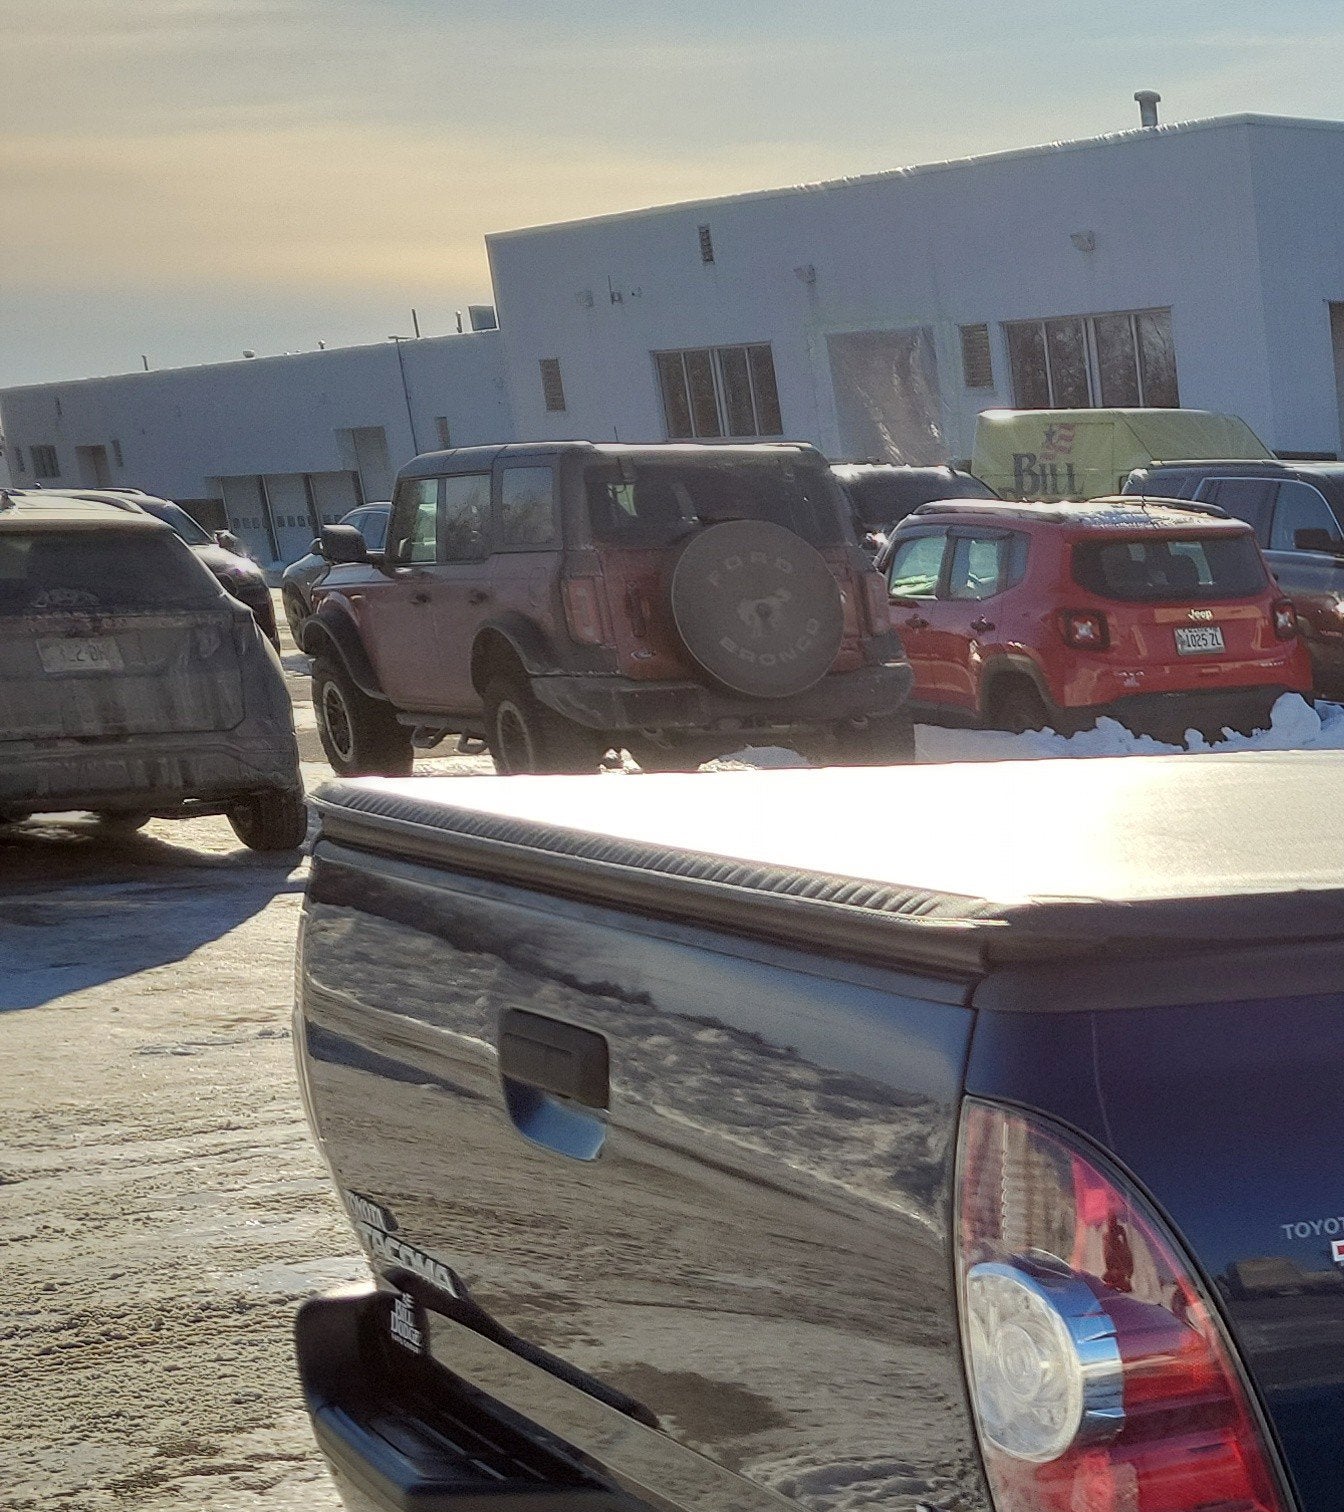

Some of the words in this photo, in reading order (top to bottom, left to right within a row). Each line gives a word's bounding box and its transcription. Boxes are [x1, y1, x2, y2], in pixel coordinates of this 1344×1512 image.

[1188, 609, 1213, 621] Jeep
[719, 618, 821, 666] BRONCO
[360, 1220, 459, 1299] TACOMA
